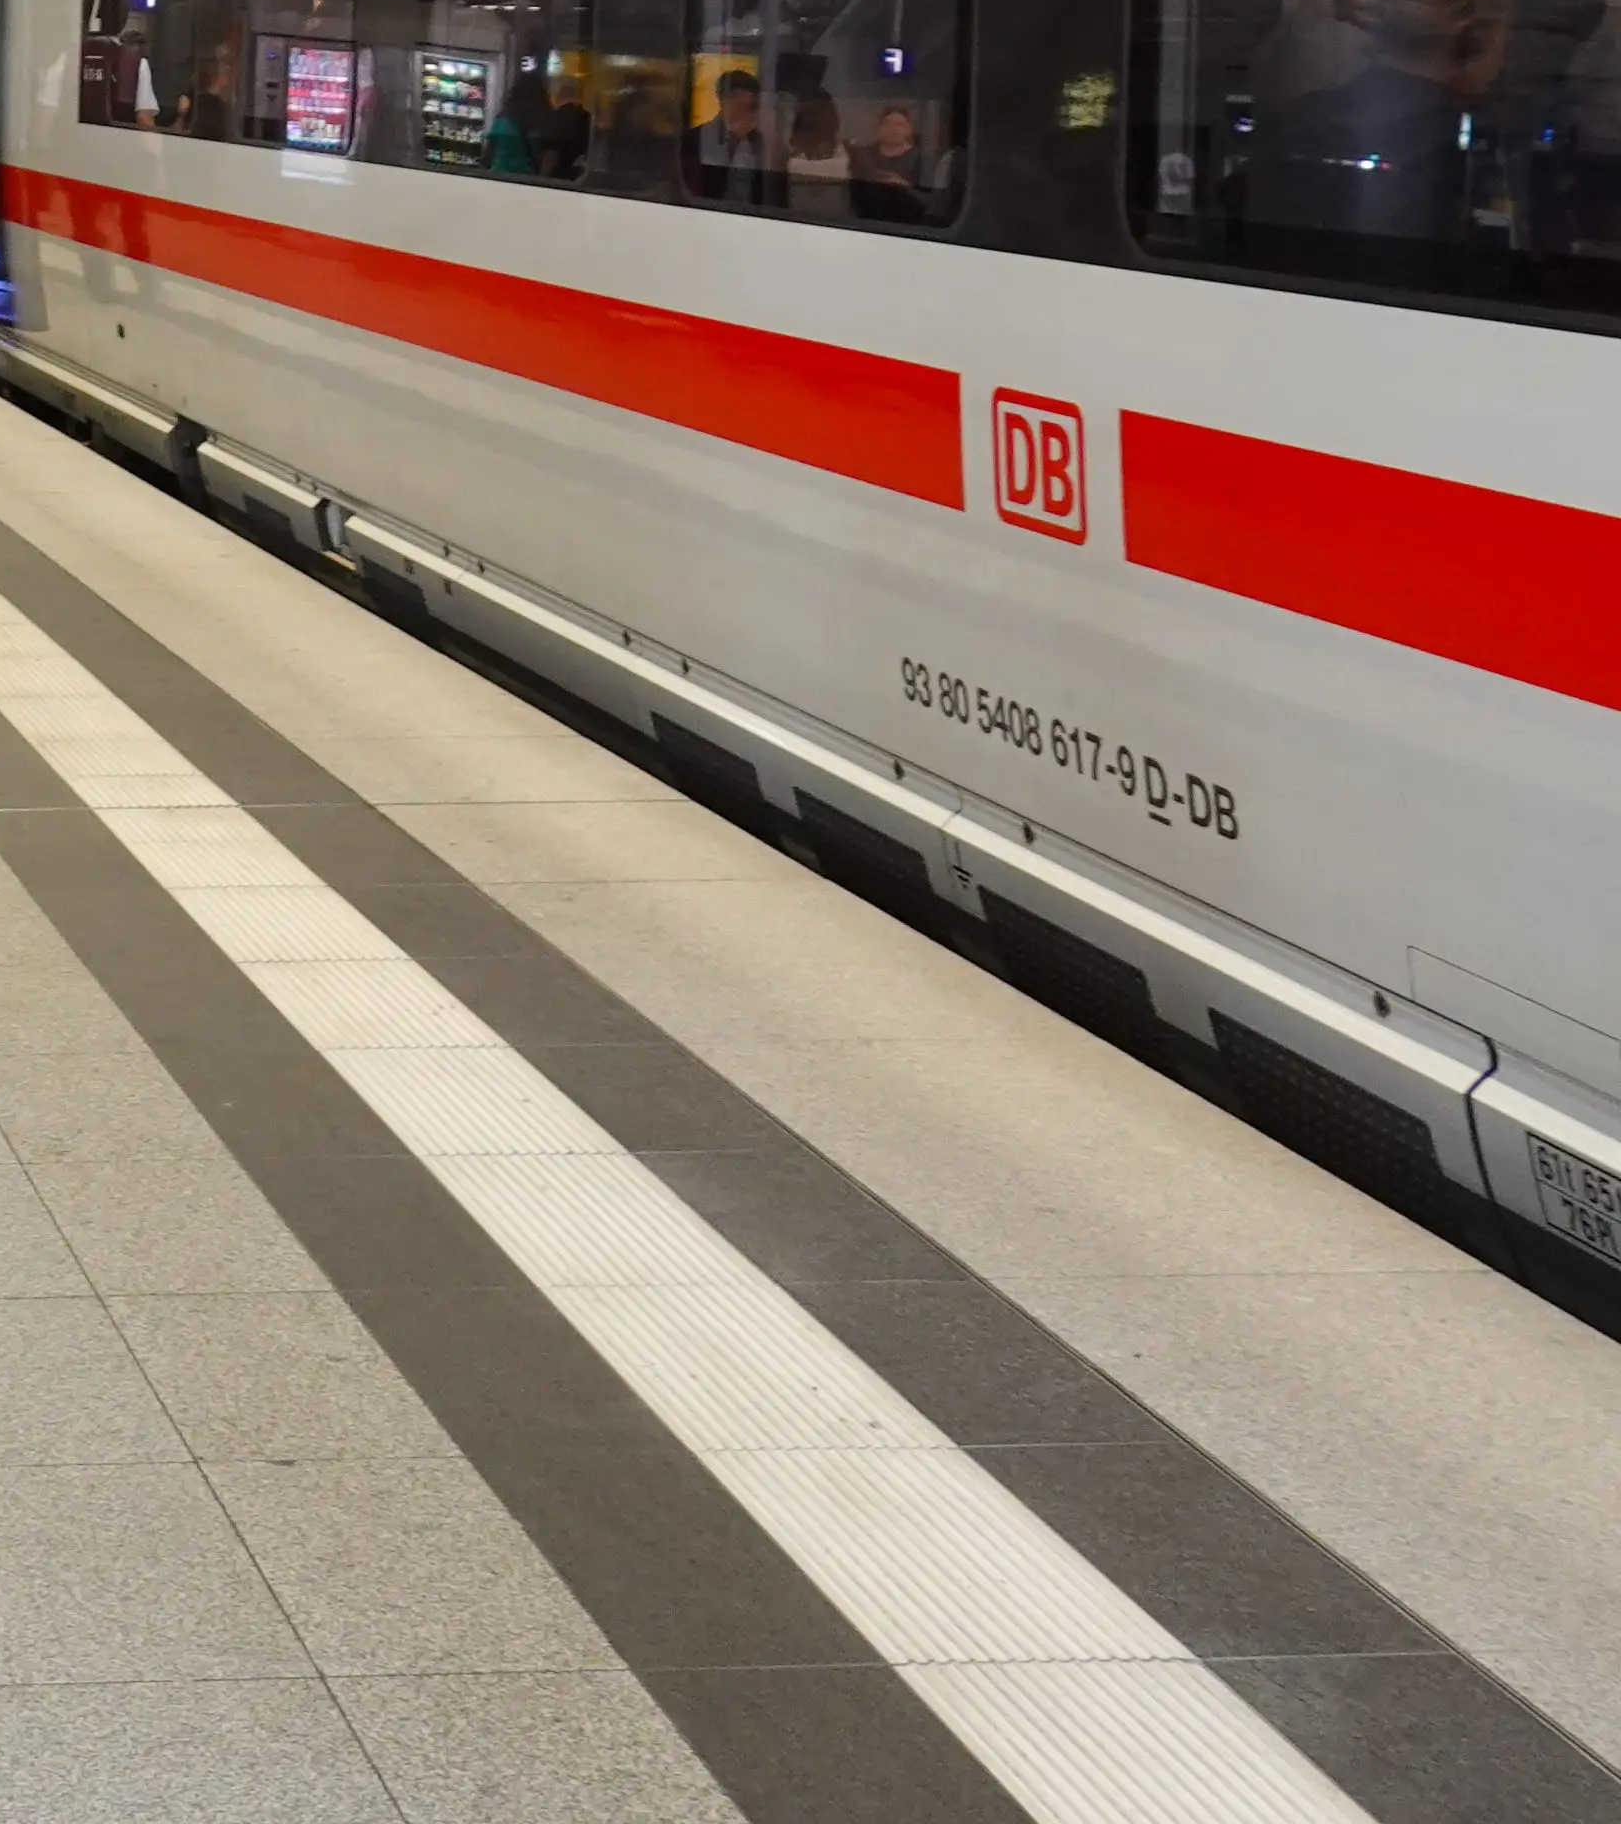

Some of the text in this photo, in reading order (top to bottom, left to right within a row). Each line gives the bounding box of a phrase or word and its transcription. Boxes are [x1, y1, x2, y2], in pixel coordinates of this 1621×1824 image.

[1004, 410, 1074, 518] DB
[902, 656, 1240, 840] 93 80 5408 617-9 D-DB
